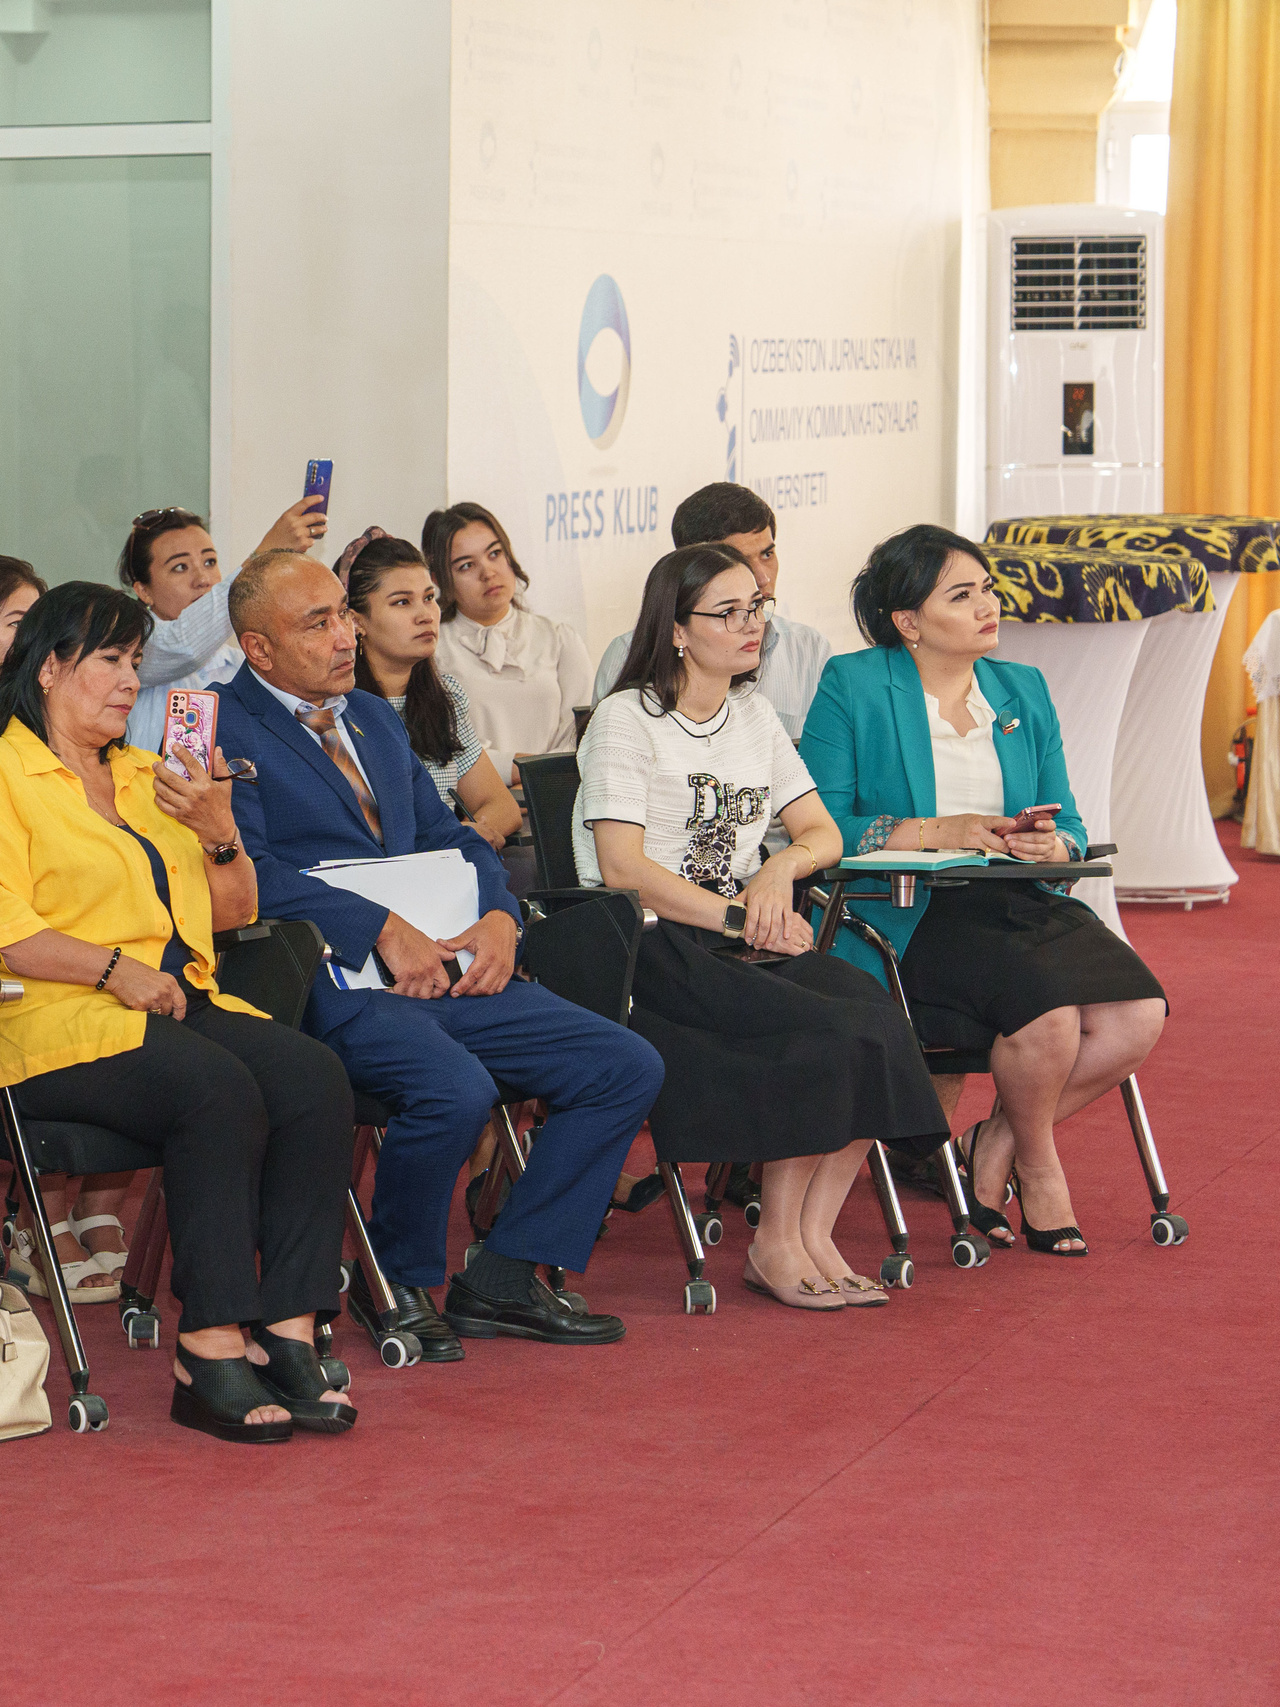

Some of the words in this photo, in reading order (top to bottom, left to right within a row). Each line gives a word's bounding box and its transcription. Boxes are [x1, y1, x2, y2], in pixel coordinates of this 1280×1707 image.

[829, 337, 902, 371] JURNALISTIKA
[903, 336, 917, 370] VA
[749, 406, 804, 443] OMMAVIY
[806, 400, 919, 440] KOMMUNIKATSIYALAR
[749, 472, 827, 510] NIVERSITETI
[545, 488, 605, 542] PRESS
[613, 485, 659, 535] KLUB
